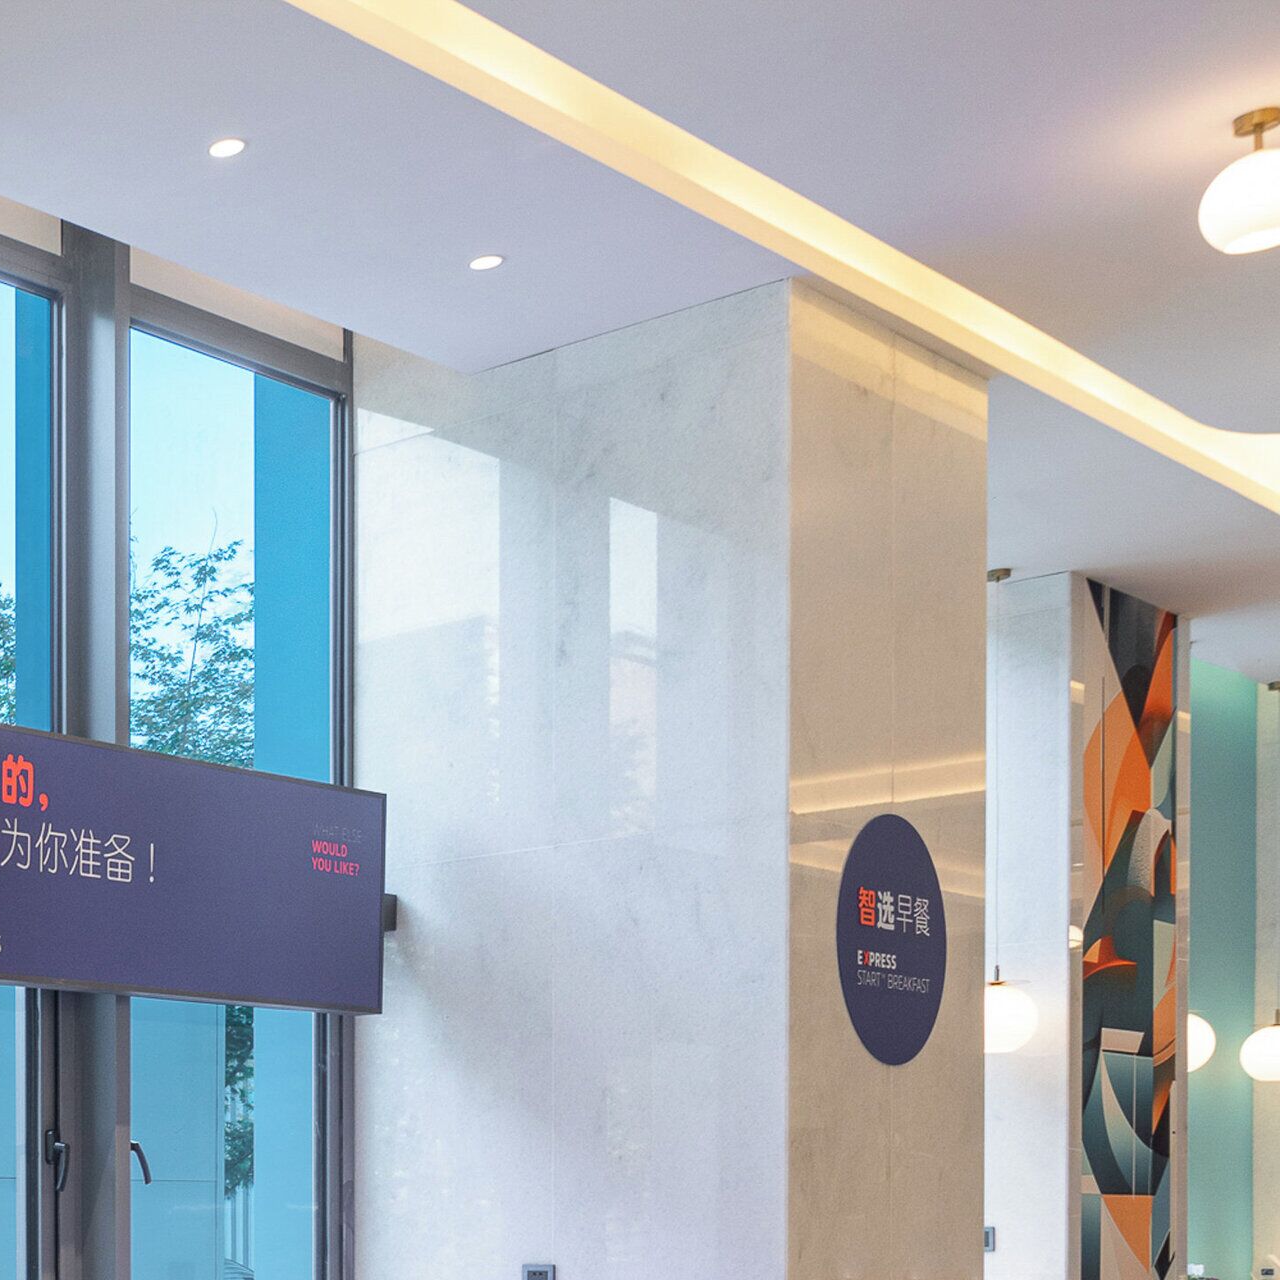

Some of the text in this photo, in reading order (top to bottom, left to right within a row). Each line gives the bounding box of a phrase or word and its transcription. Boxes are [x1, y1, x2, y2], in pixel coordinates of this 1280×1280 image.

[311, 839, 348, 858] WOULD
[311, 856, 360, 876] YOU LIKE?
[857, 886, 930, 937] 智选早餐
[857, 949, 897, 970] EXPRESS
[887, 972, 930, 994] BREAKFAST
